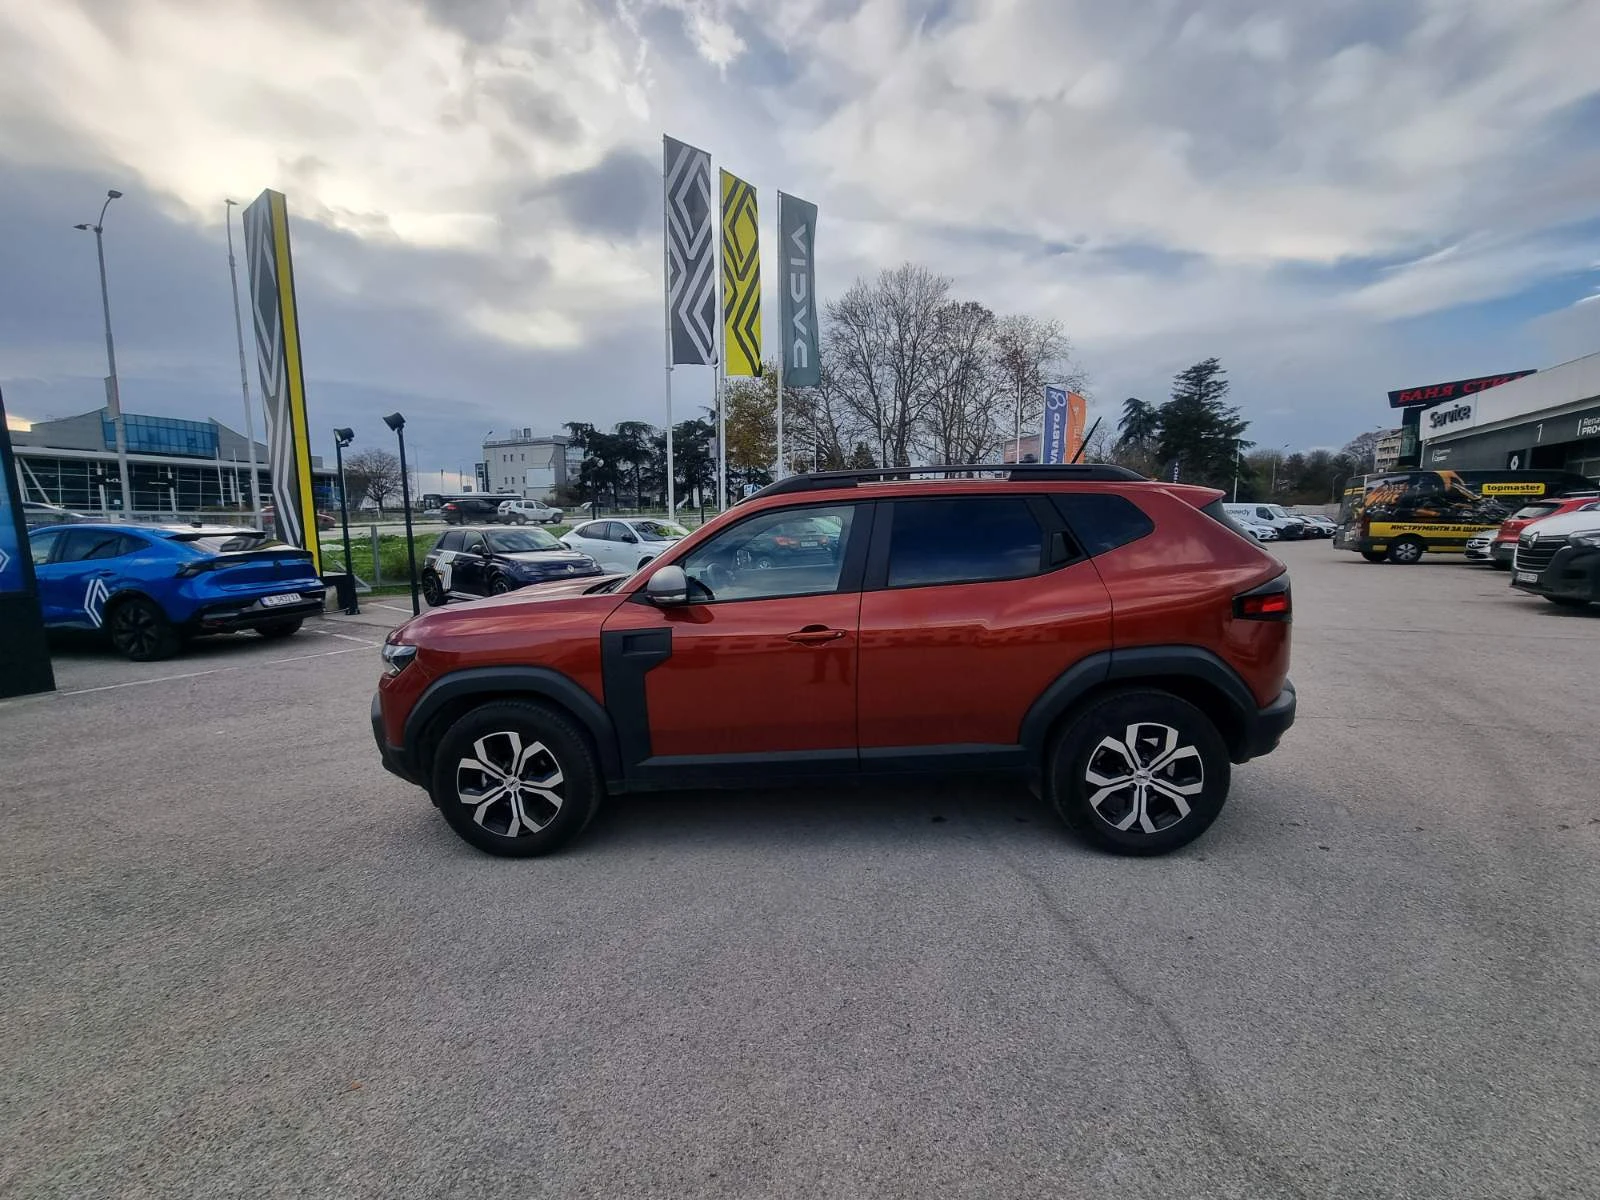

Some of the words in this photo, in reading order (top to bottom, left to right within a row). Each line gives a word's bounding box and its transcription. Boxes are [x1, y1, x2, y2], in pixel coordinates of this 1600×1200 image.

[790, 223, 808, 368] DACIA
[1399, 384, 1455, 403] БАНЯ
[1430, 404, 1472, 429] Service
[1390, 524, 1450, 532] ИНСТРУМЕНТИ
